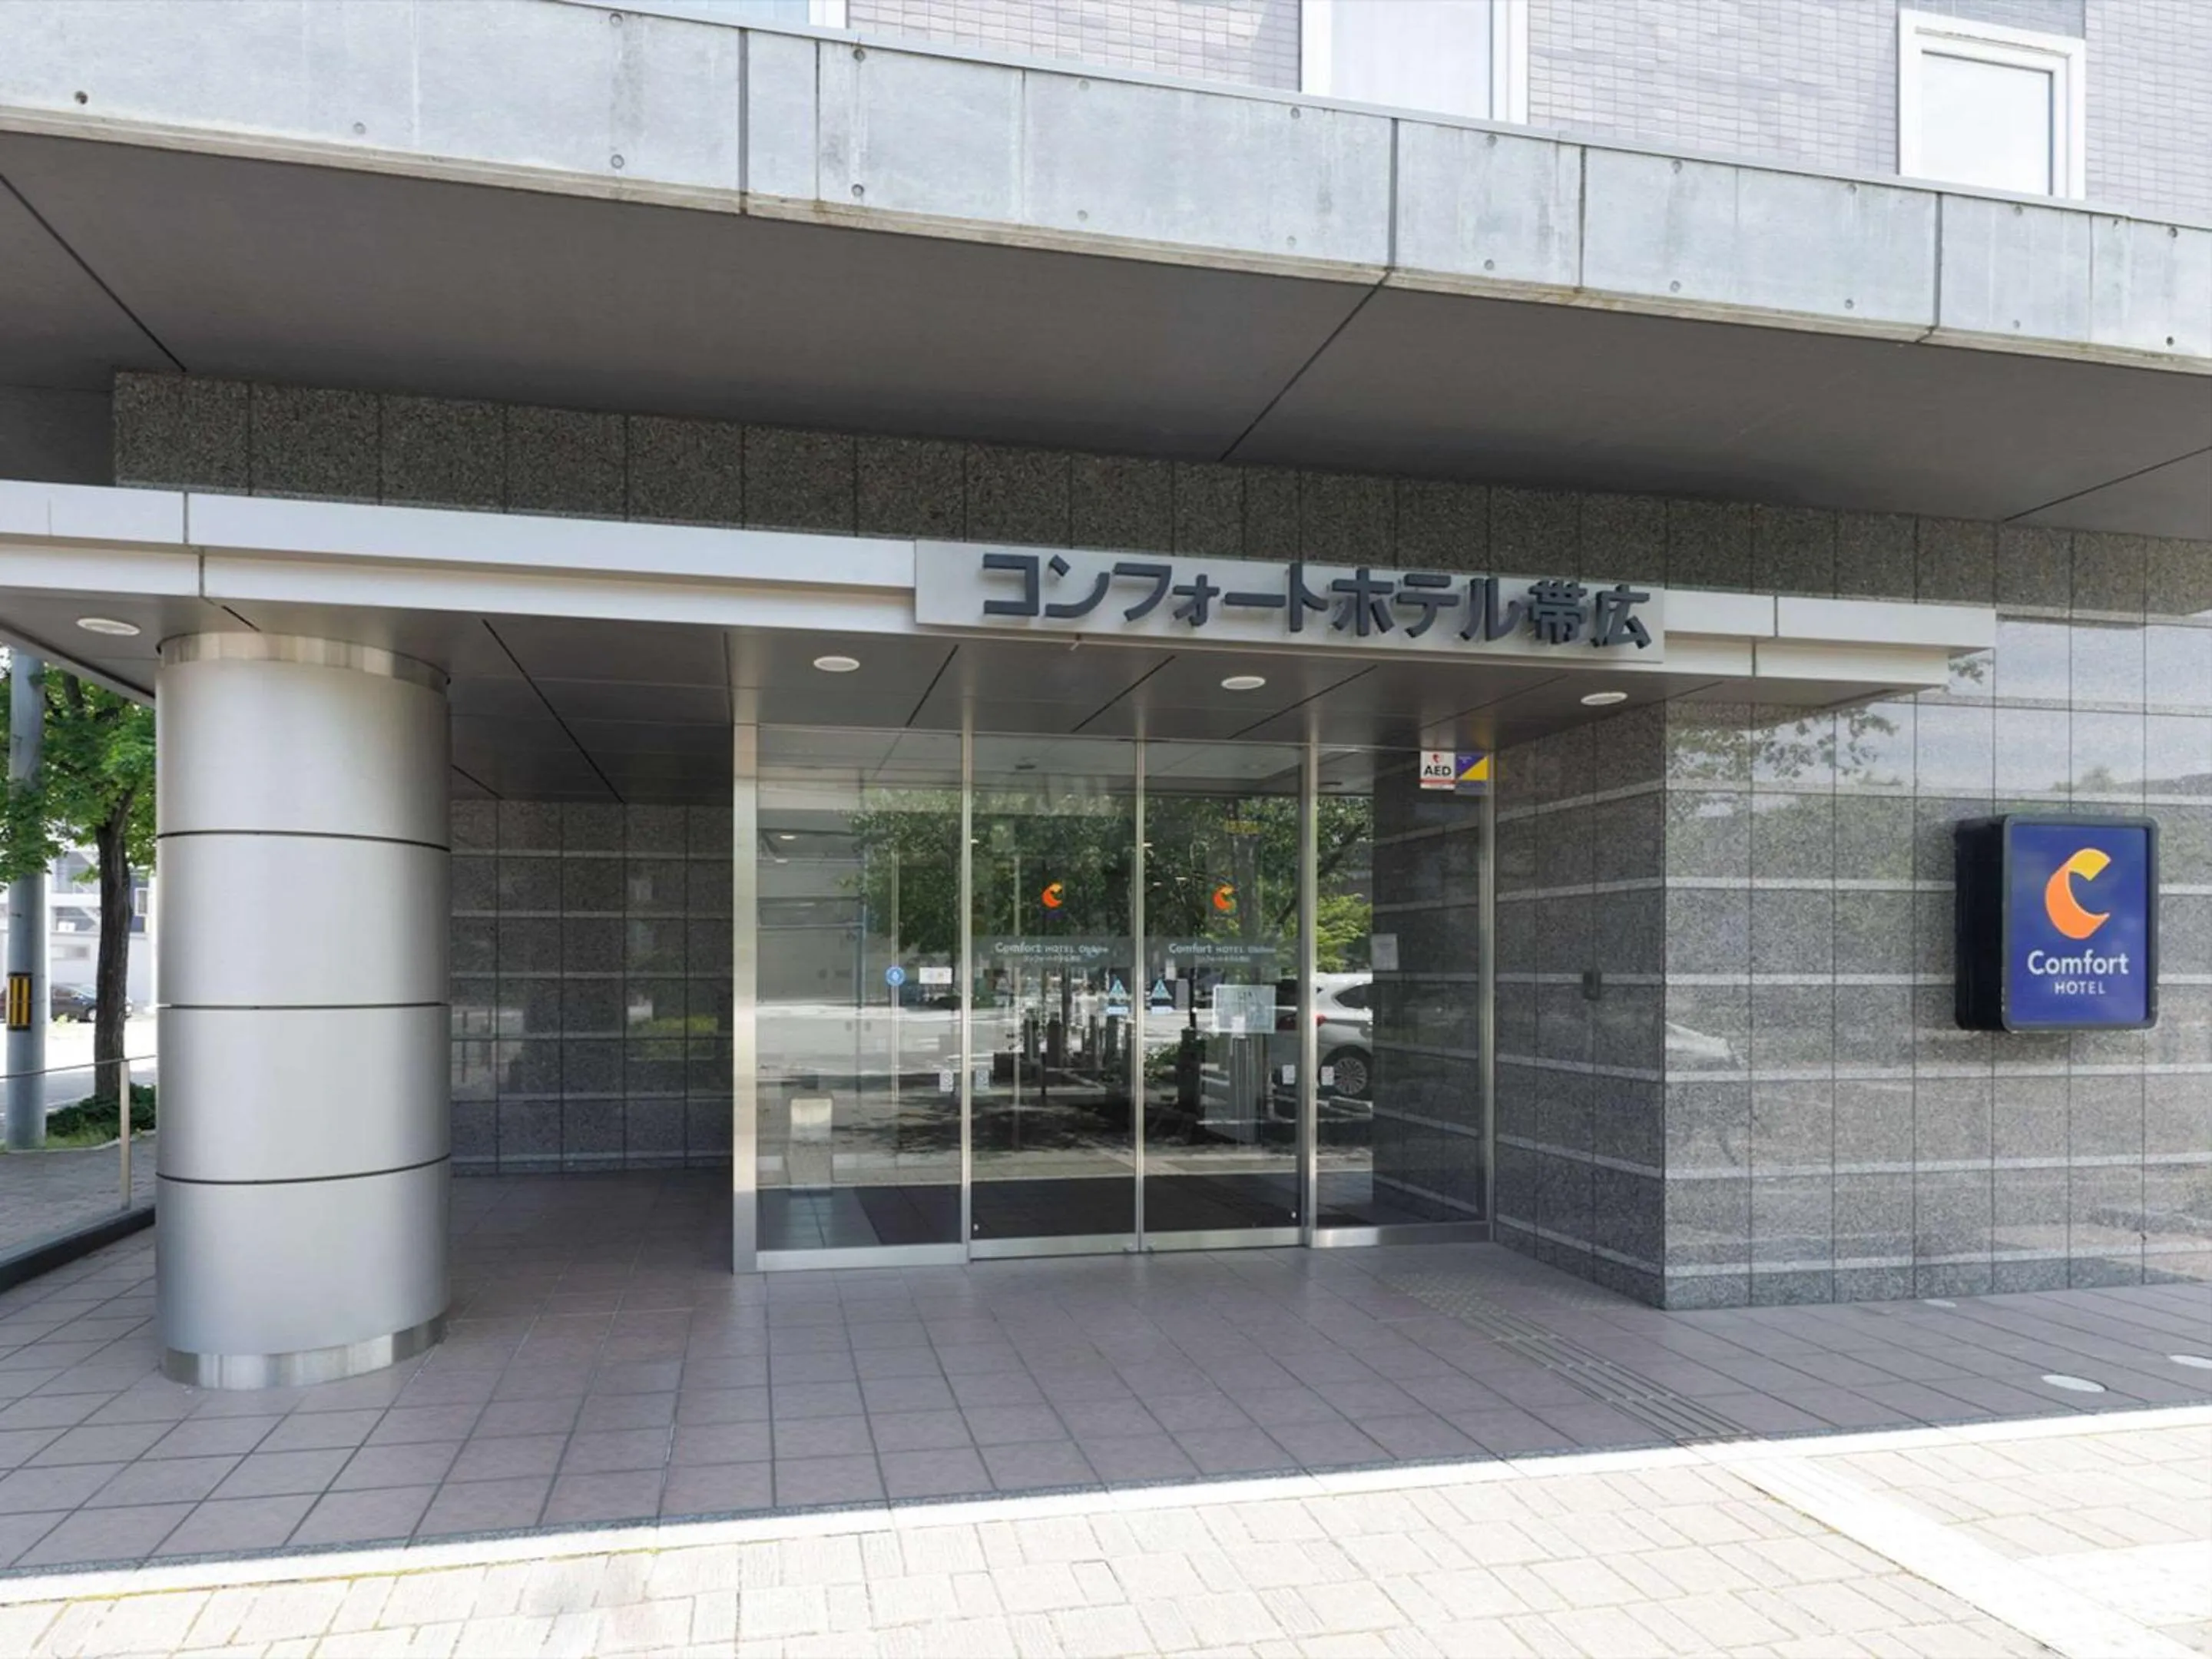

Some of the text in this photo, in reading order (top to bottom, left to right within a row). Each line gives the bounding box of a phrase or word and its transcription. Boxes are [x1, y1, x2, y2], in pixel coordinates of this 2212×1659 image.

[982, 552, 1653, 650] コンフォートホテル帯広
[1424, 765, 1452, 777] AED
[995, 941, 1042, 954] Comfort
[1168, 942, 1212, 954] Comfort
[2027, 949, 2130, 975] Comfort
[2055, 980, 2106, 995] HOTEL
